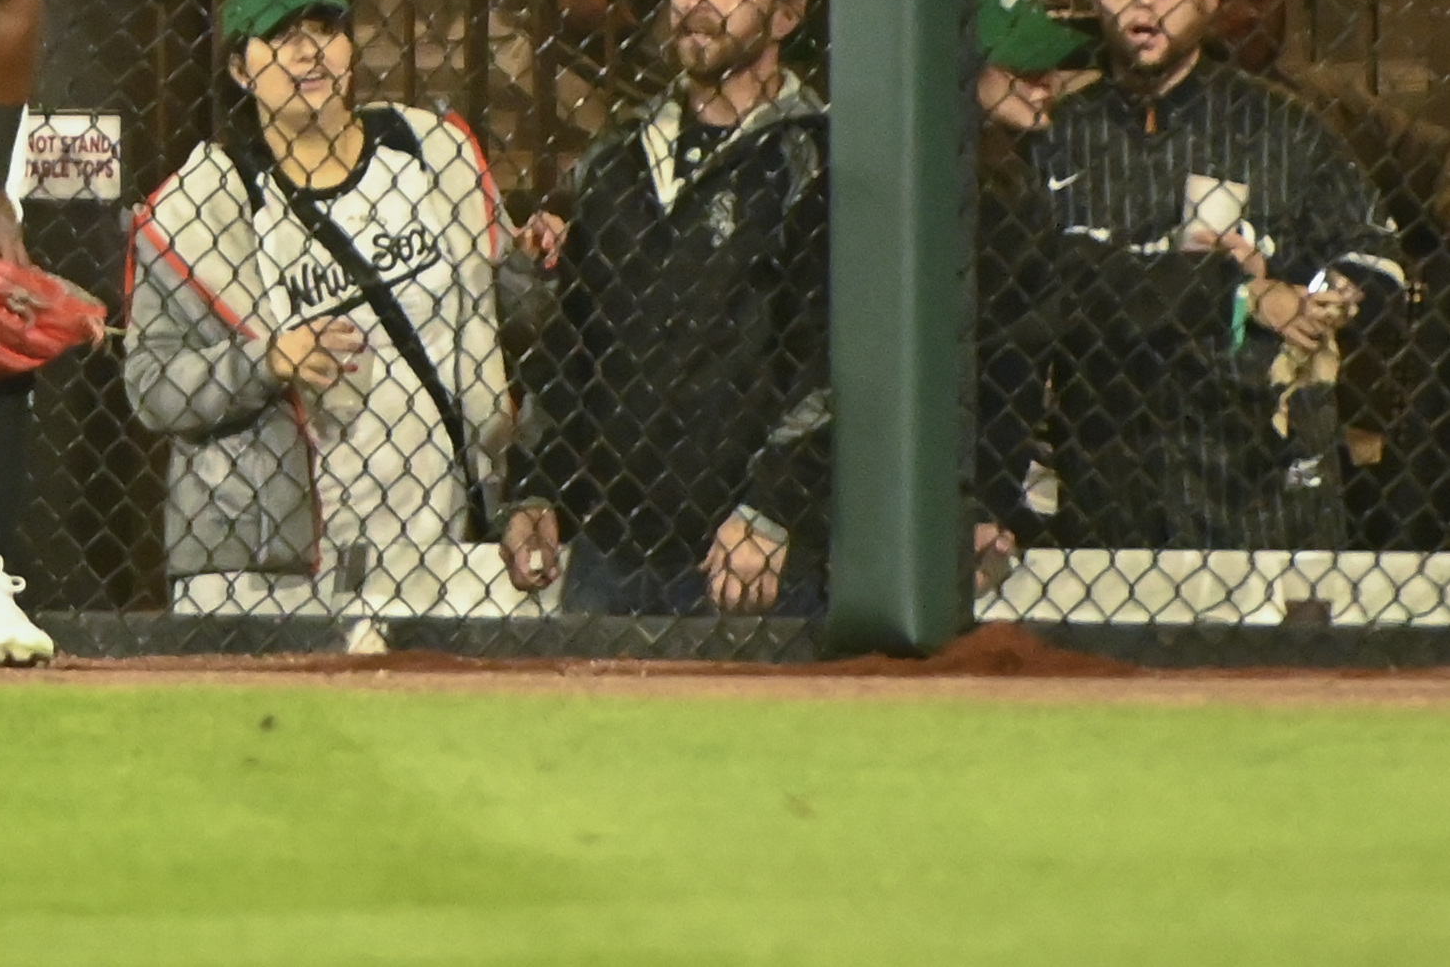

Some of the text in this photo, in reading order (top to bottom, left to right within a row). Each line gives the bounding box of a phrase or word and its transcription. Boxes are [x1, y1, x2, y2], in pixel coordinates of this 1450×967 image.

[61, 135, 110, 153] STAND
[74, 159, 113, 178] TOPS
[372, 224, 438, 272] Sox
